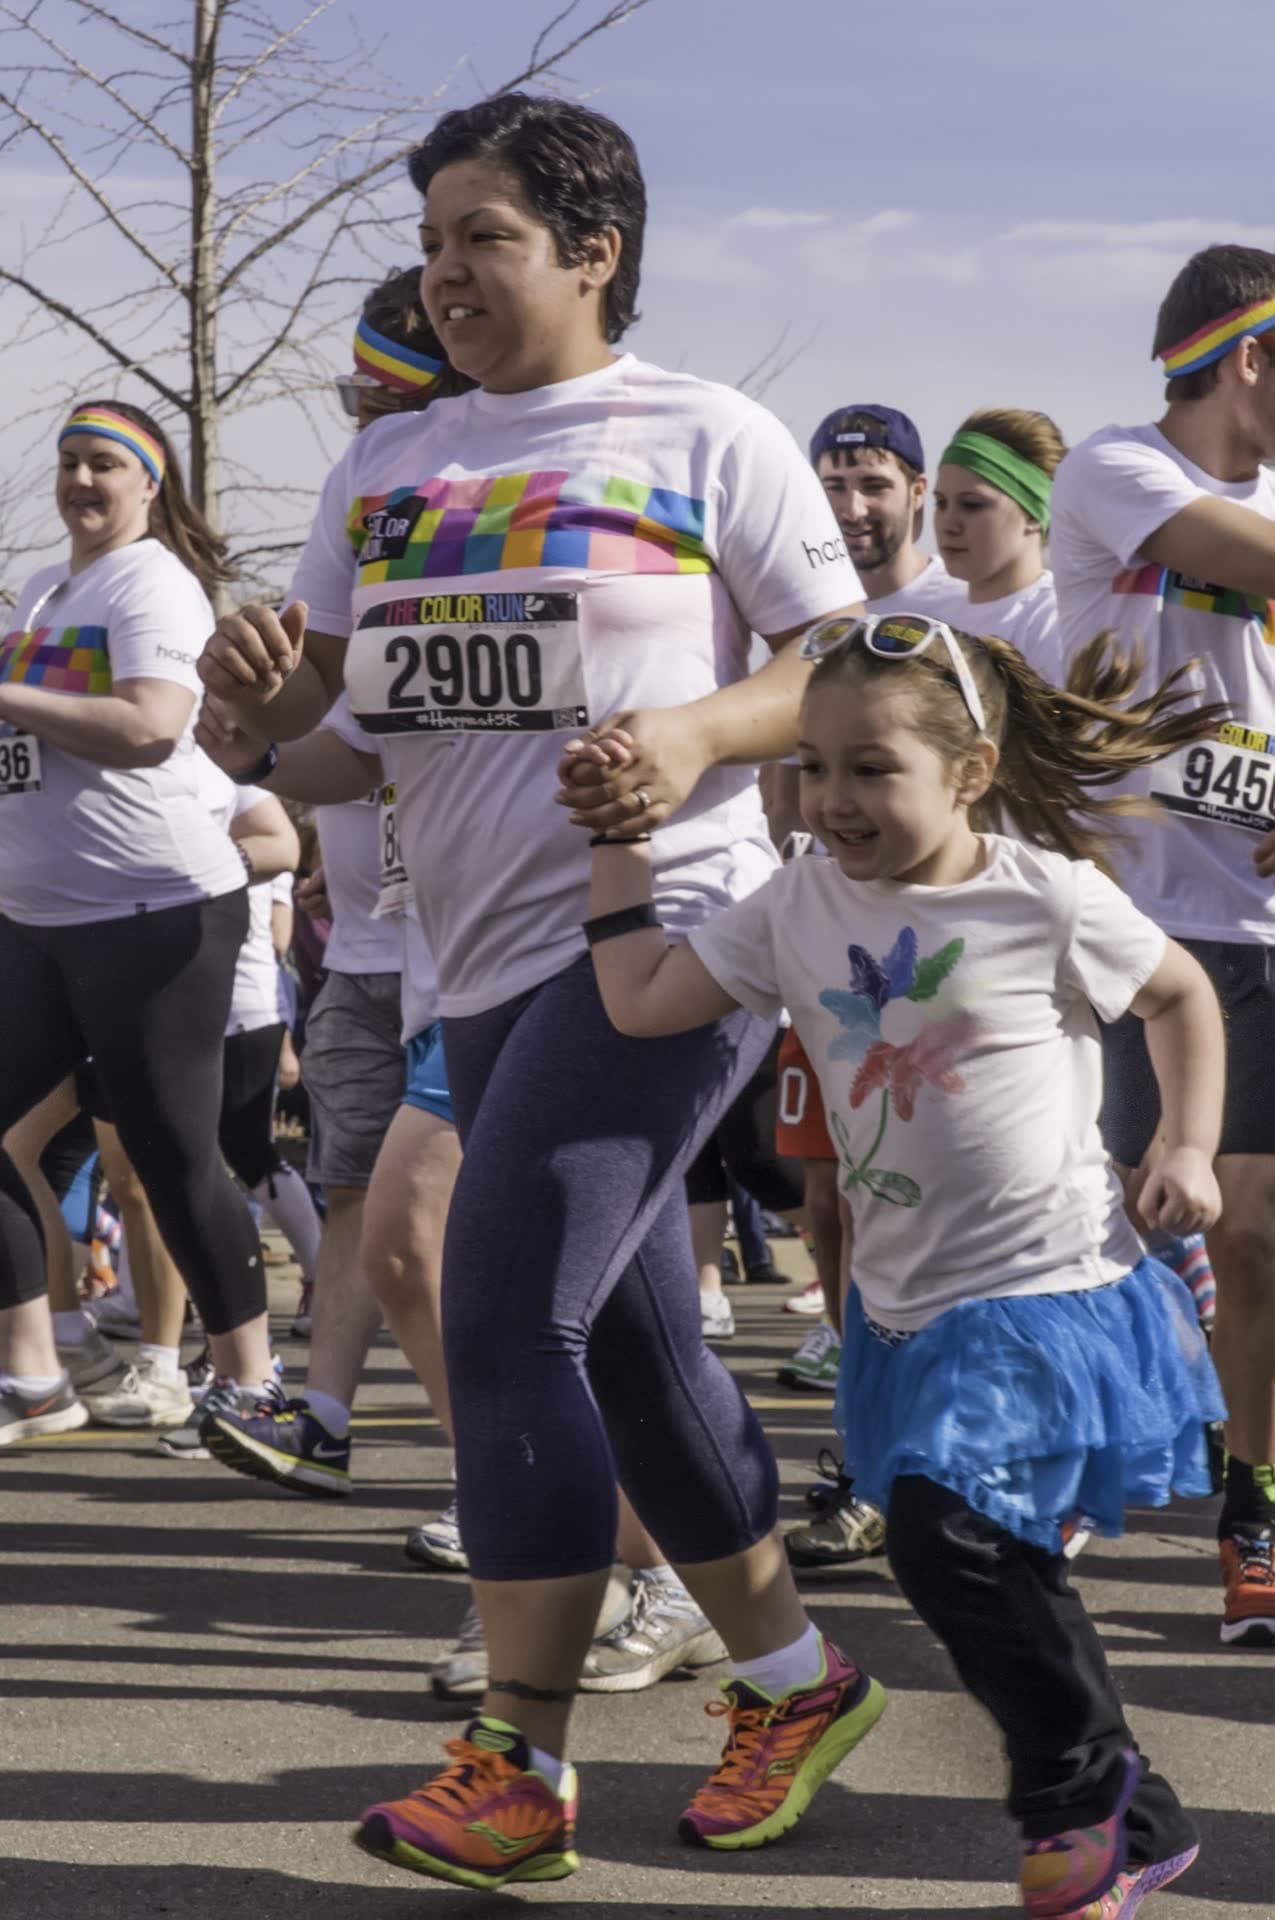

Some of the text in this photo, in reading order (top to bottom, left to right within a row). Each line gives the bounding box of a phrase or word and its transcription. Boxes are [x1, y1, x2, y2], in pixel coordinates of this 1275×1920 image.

[384, 593, 524, 626] THE COLOR RUN
[385, 634, 542, 709] 2900
[1220, 724, 1268, 753] COLOR
